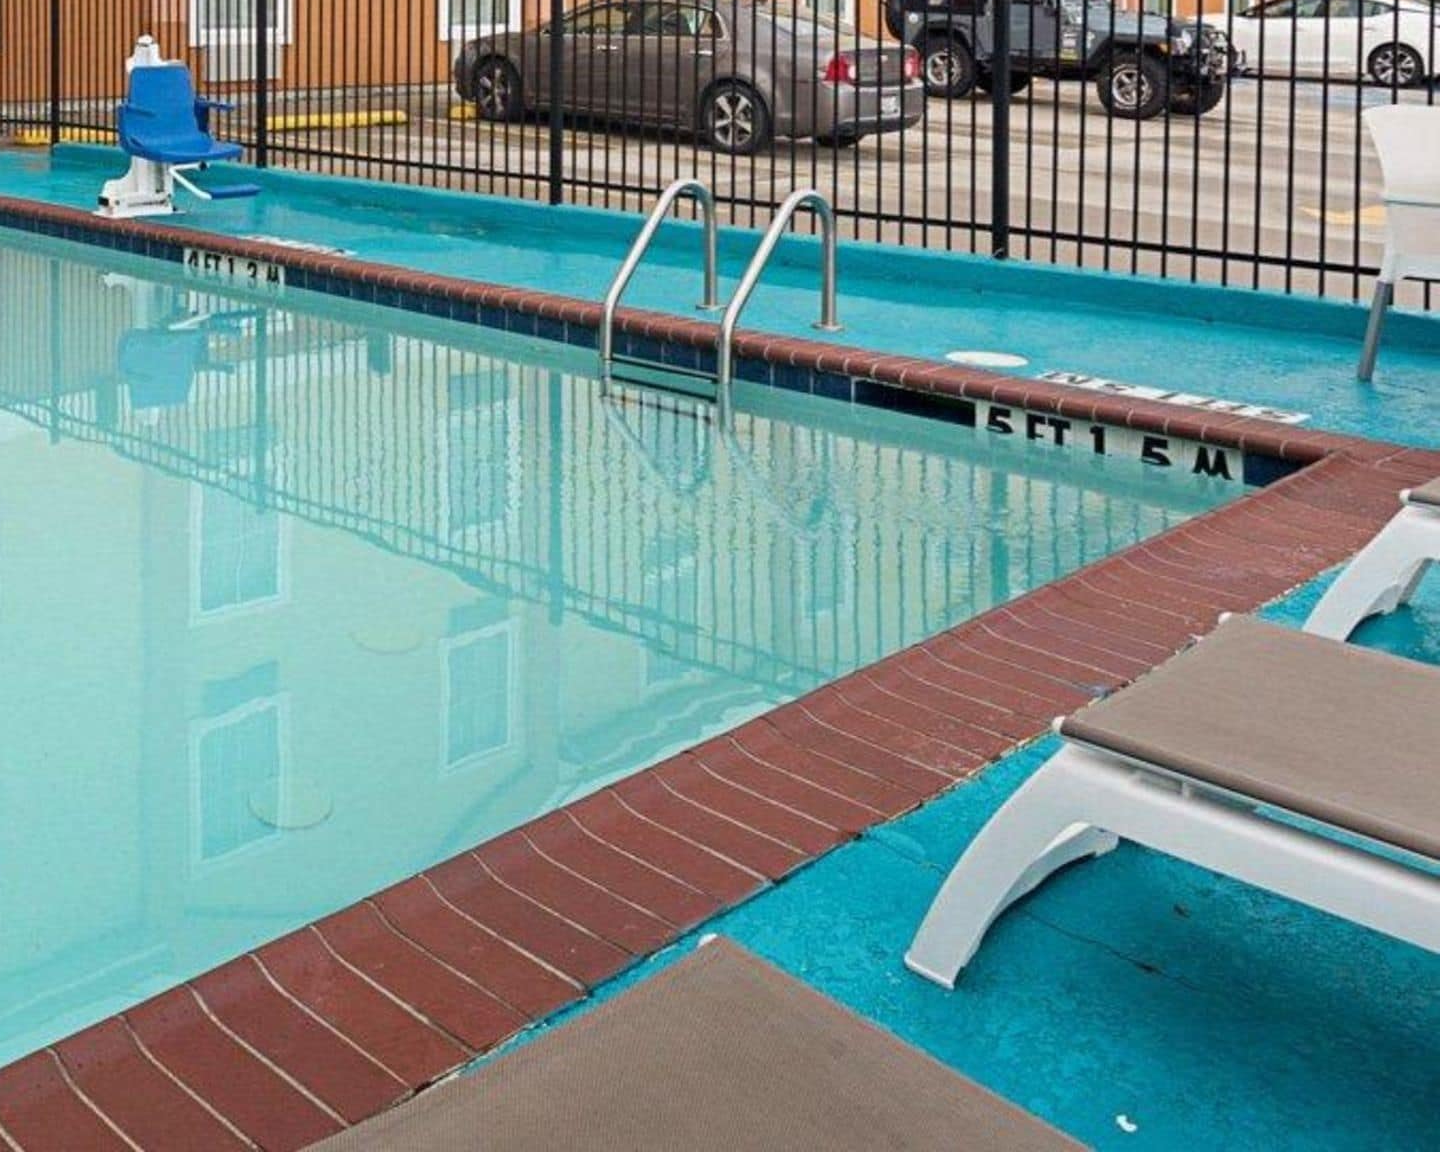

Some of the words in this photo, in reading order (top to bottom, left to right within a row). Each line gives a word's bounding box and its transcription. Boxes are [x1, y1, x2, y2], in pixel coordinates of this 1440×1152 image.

[985, 405, 1015, 435] 5
[1025, 413, 1072, 448] FT
[1192, 446, 1235, 482] M
